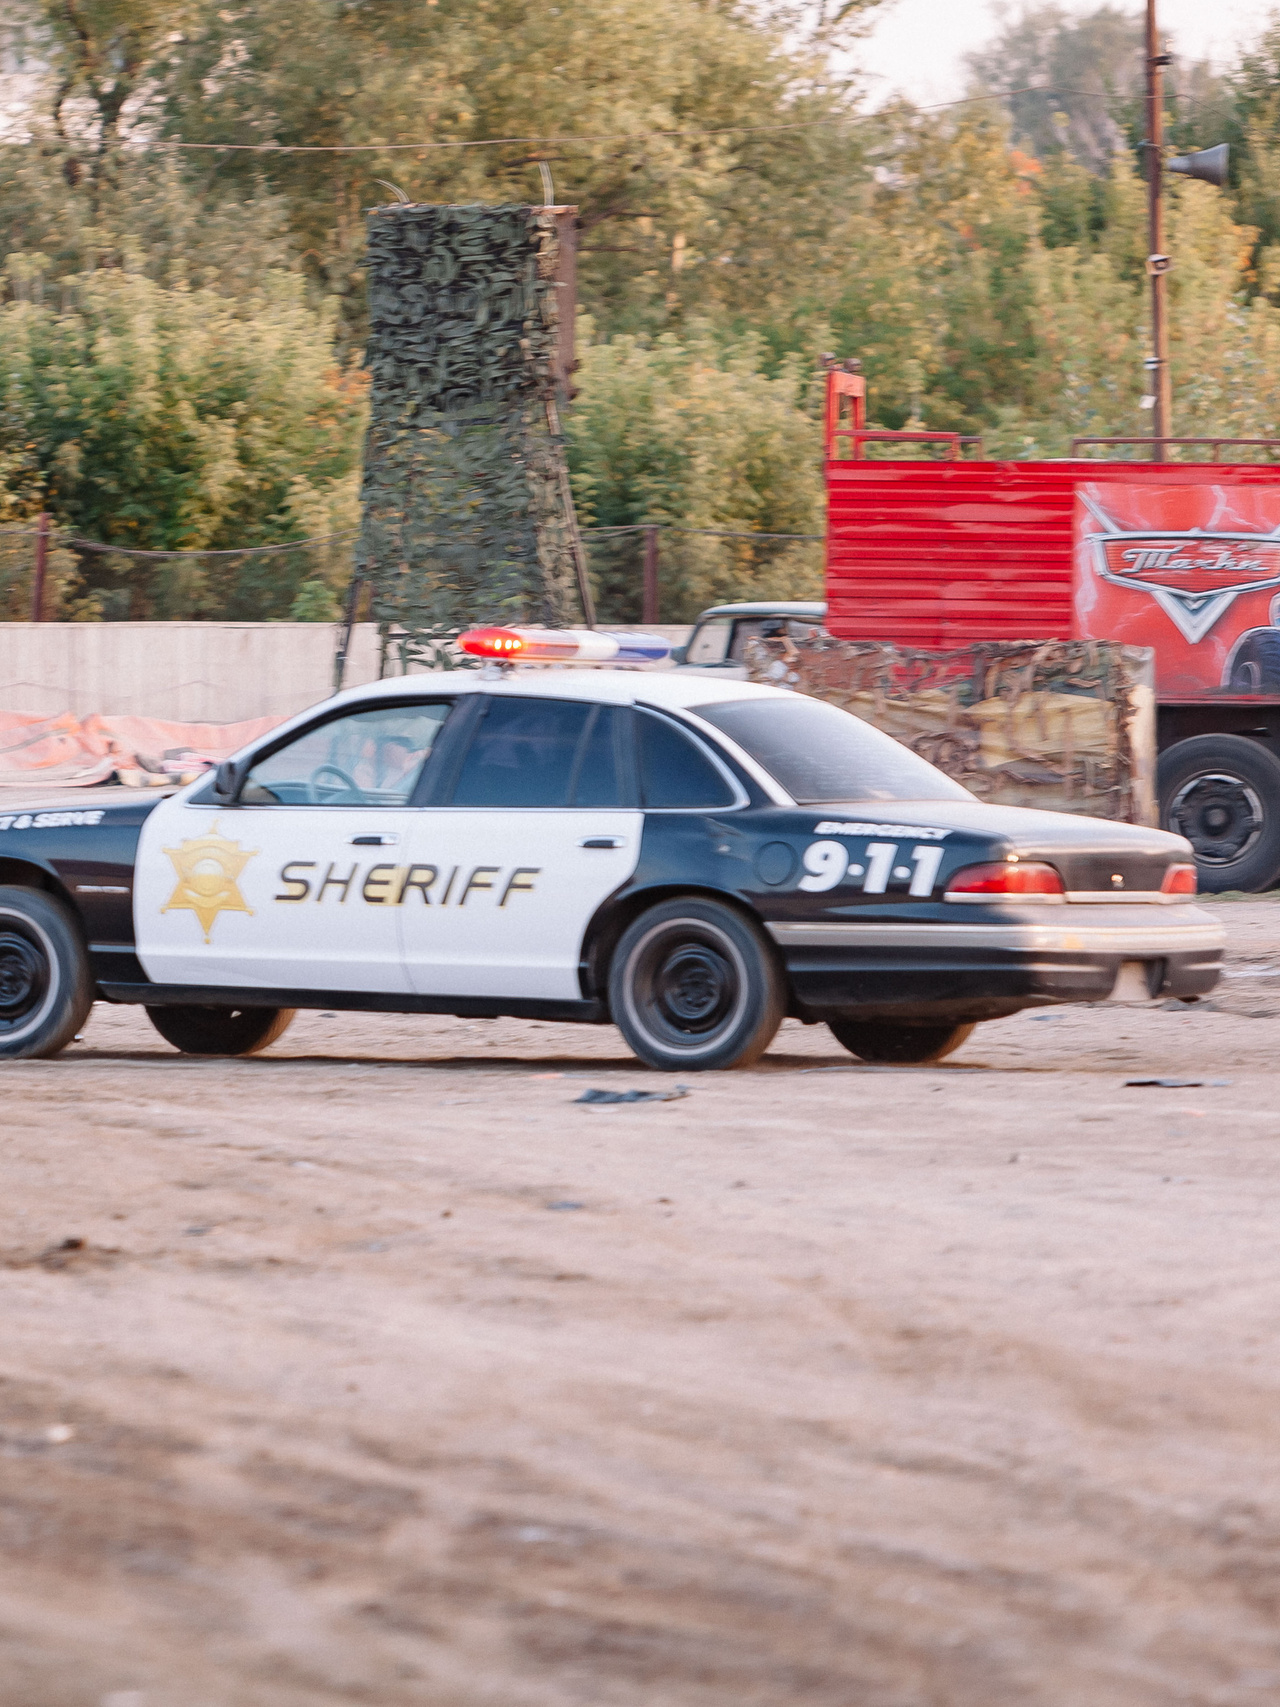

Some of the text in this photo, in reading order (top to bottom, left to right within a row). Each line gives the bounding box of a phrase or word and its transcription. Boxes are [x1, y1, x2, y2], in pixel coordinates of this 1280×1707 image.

[32, 810, 106, 828] SERVE
[813, 821, 955, 841] EMERGENCY
[274, 861, 542, 908] SHERIFF
